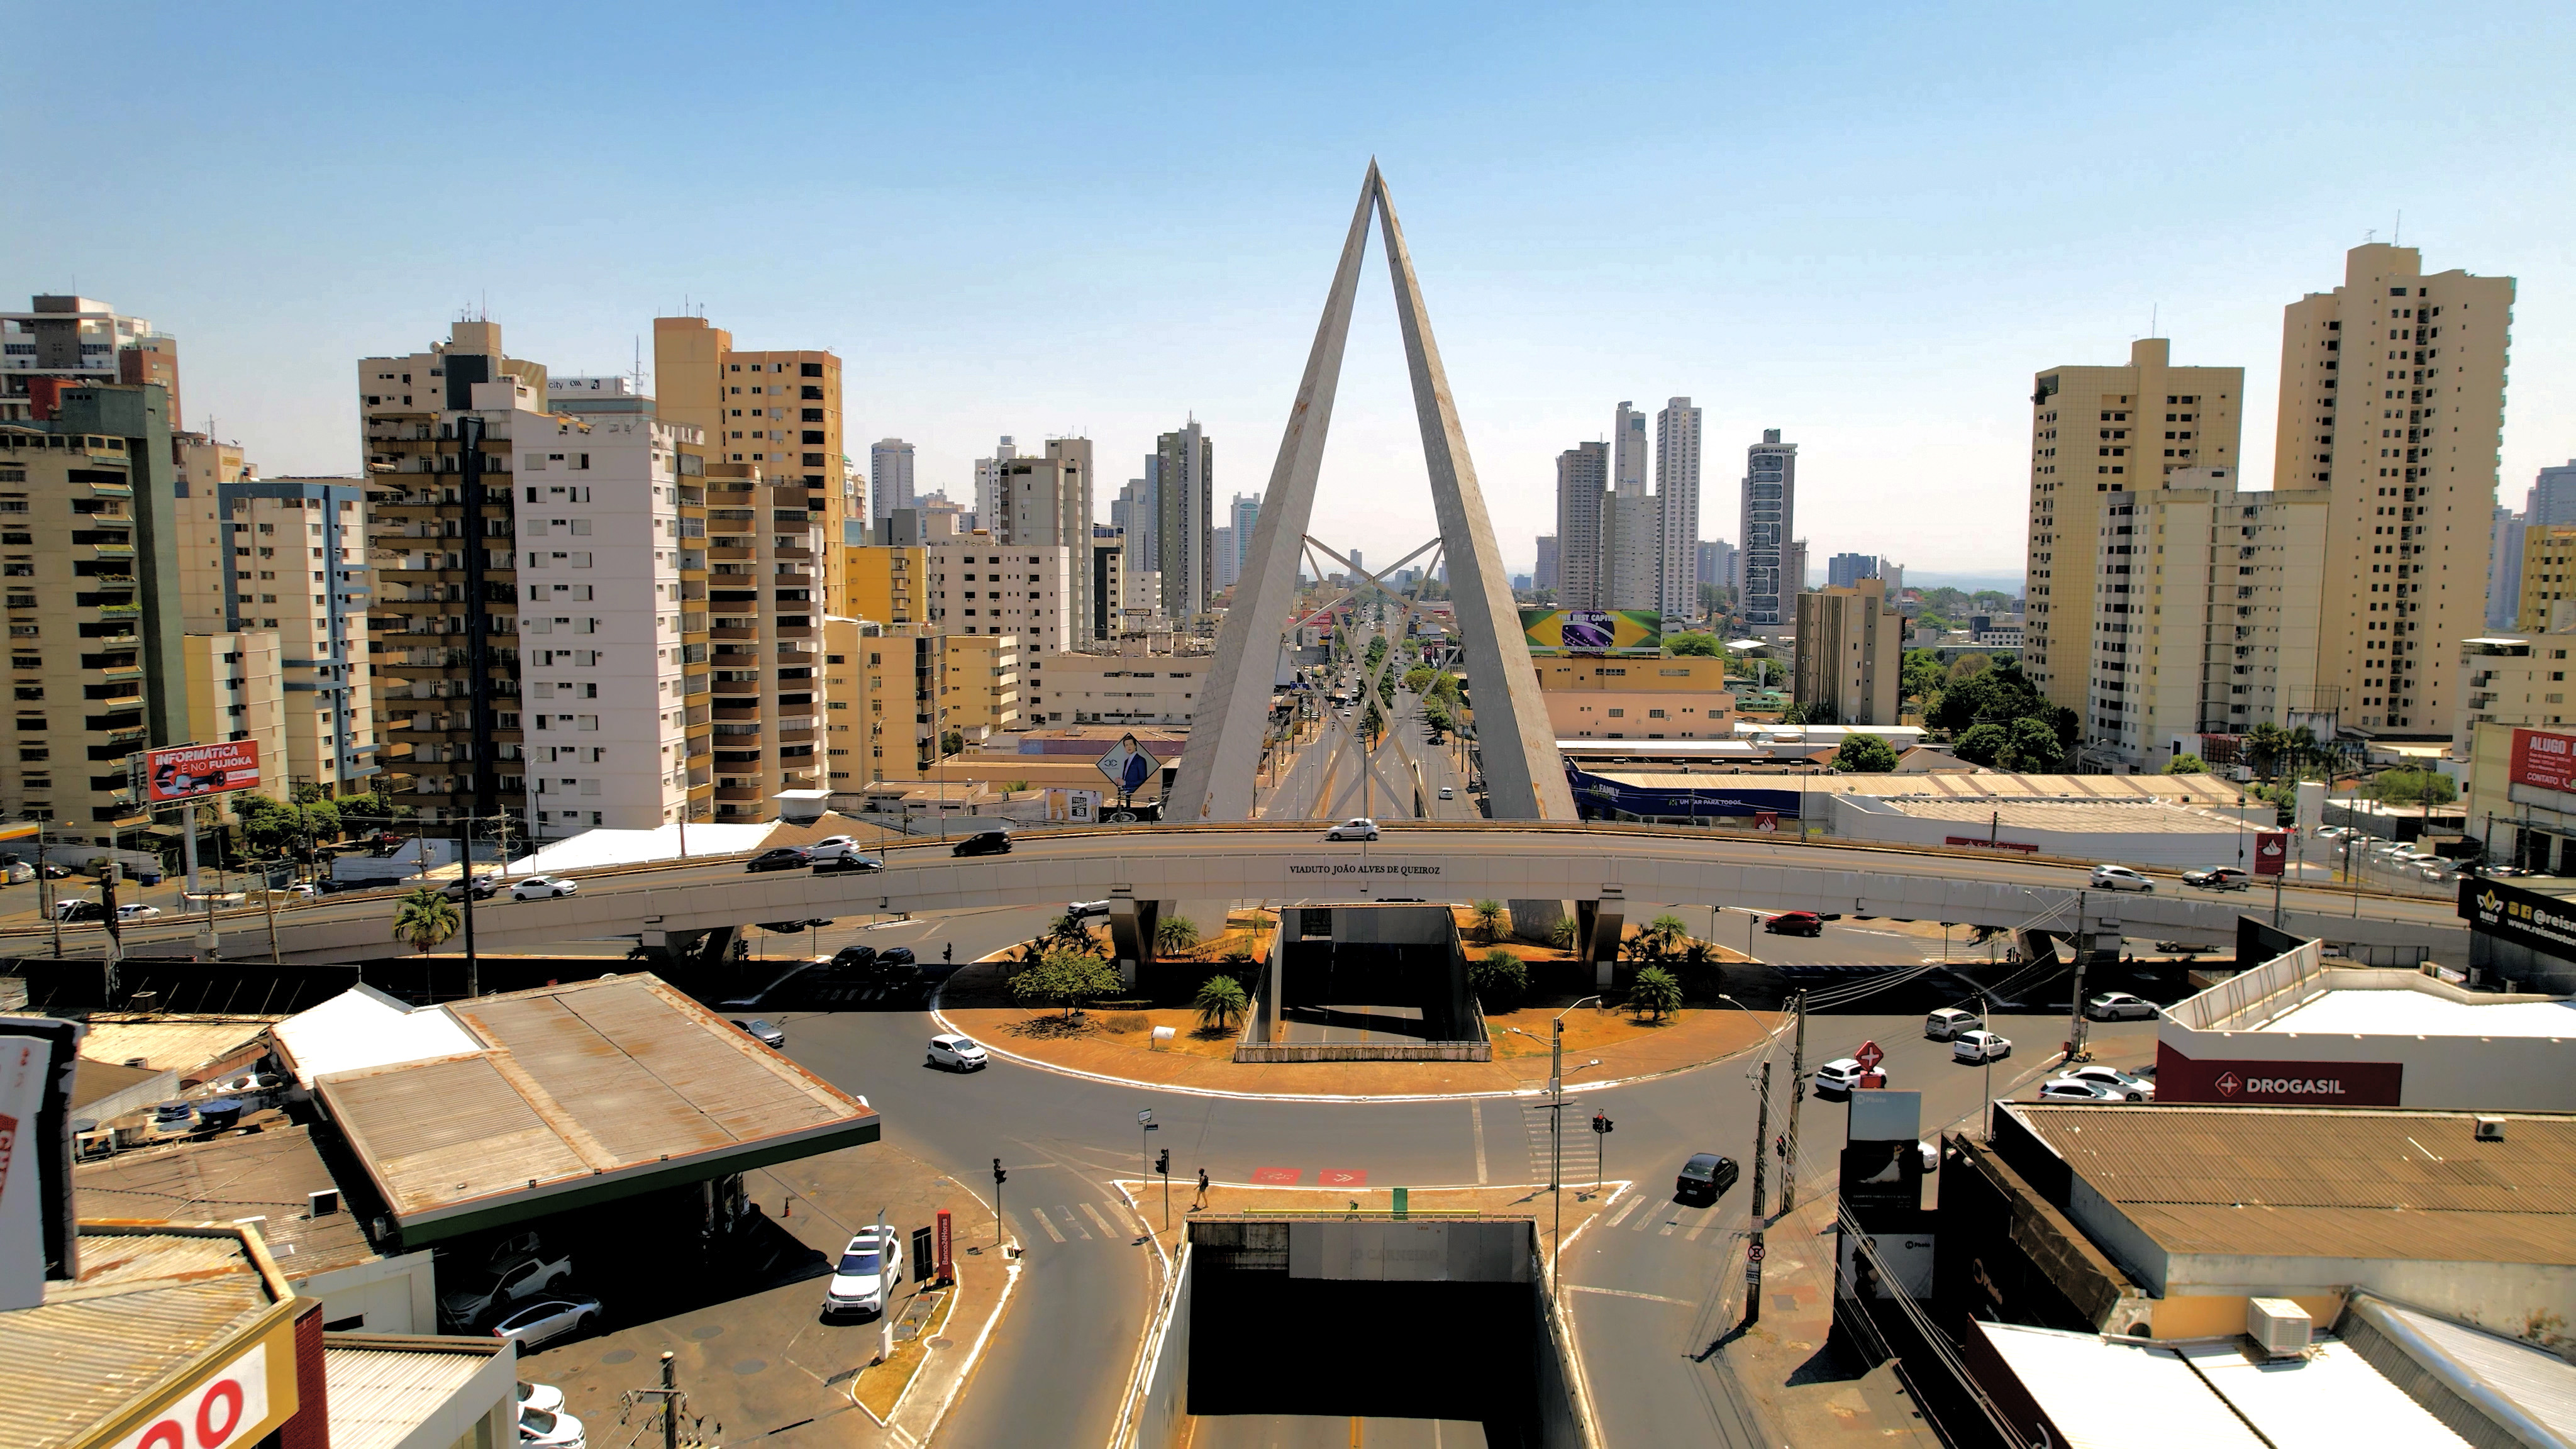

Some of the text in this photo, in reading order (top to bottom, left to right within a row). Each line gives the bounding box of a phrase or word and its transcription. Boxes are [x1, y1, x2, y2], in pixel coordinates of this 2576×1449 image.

[548, 381, 564, 390] city
[1591, 614, 1619, 622] CAPITAL
[2529, 736, 2567, 754] ALUGO
[190, 761, 207, 772] NO
[208, 755, 252, 770] FUJIOKA
[2526, 772, 2559, 785] CONTATO
[1599, 783, 1620, 797] FAMILY
[1331, 864, 1356, 875] JOÃO
[1401, 866, 1440, 876] QUEIROZ
[2479, 910, 2499, 923] REIS
[2507, 918, 2576, 946] www.reismotor
[2246, 1078, 2346, 1094] DROGASIL
